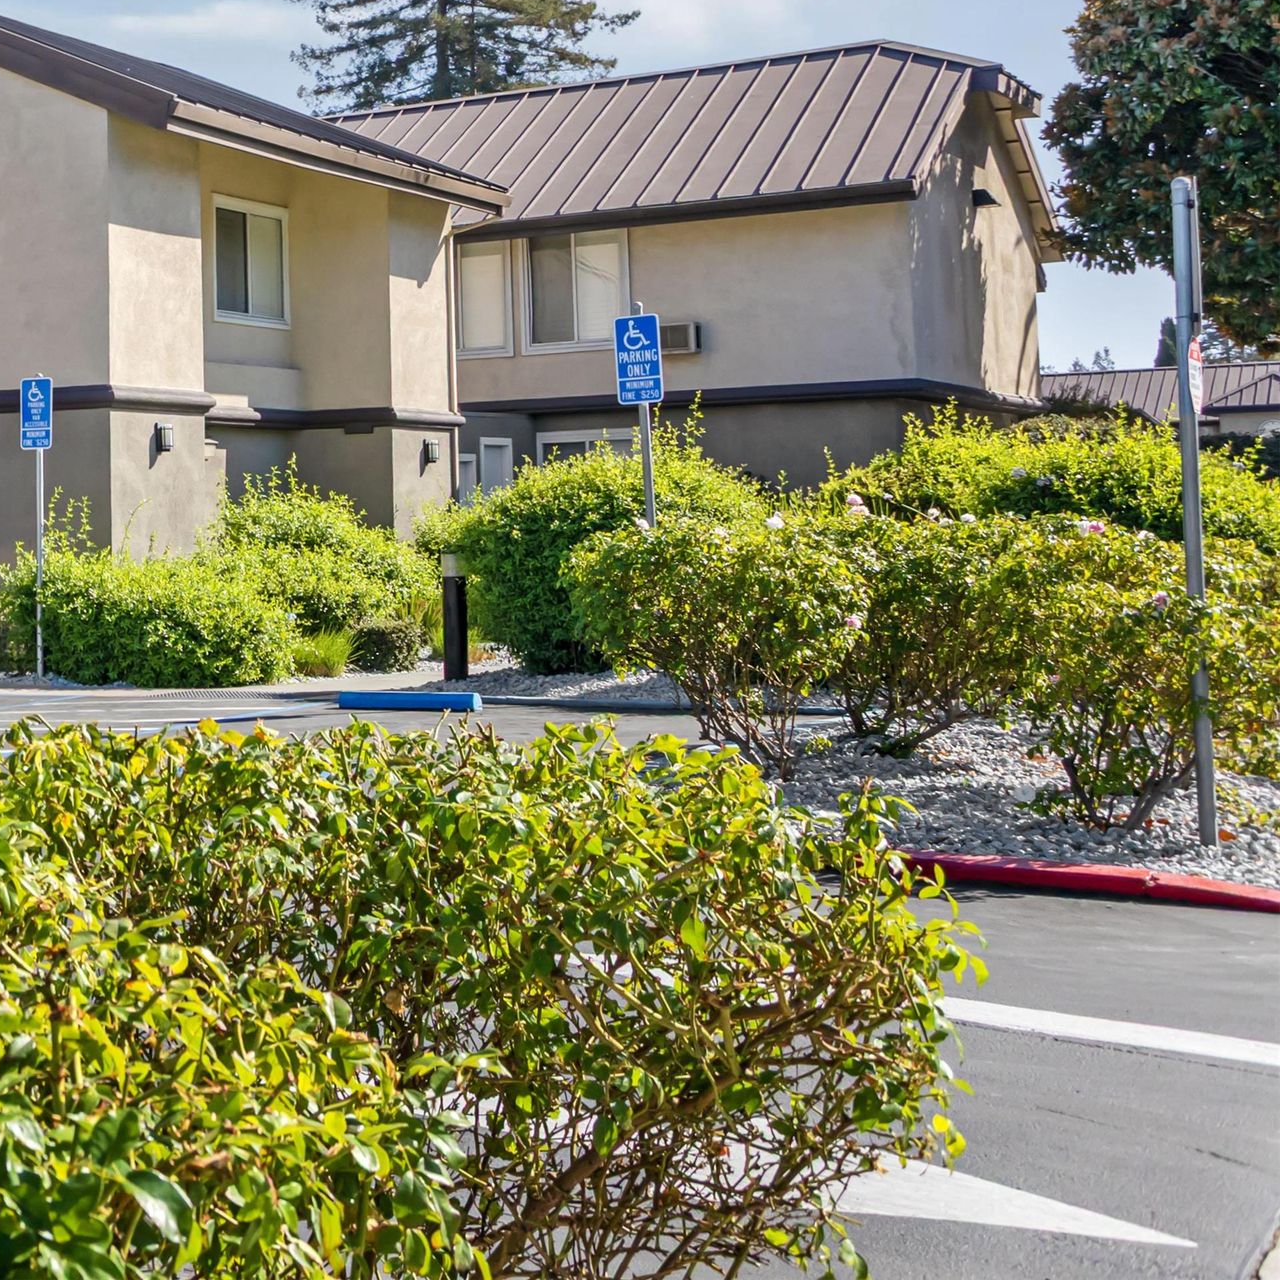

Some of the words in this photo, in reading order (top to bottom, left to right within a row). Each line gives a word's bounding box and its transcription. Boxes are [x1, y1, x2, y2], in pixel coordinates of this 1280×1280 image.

[618, 348, 658, 364] PARKING
[627, 363, 651, 377] ONLY
[625, 380, 654, 390] MINIMUM
[622, 391, 636, 400] FINE
